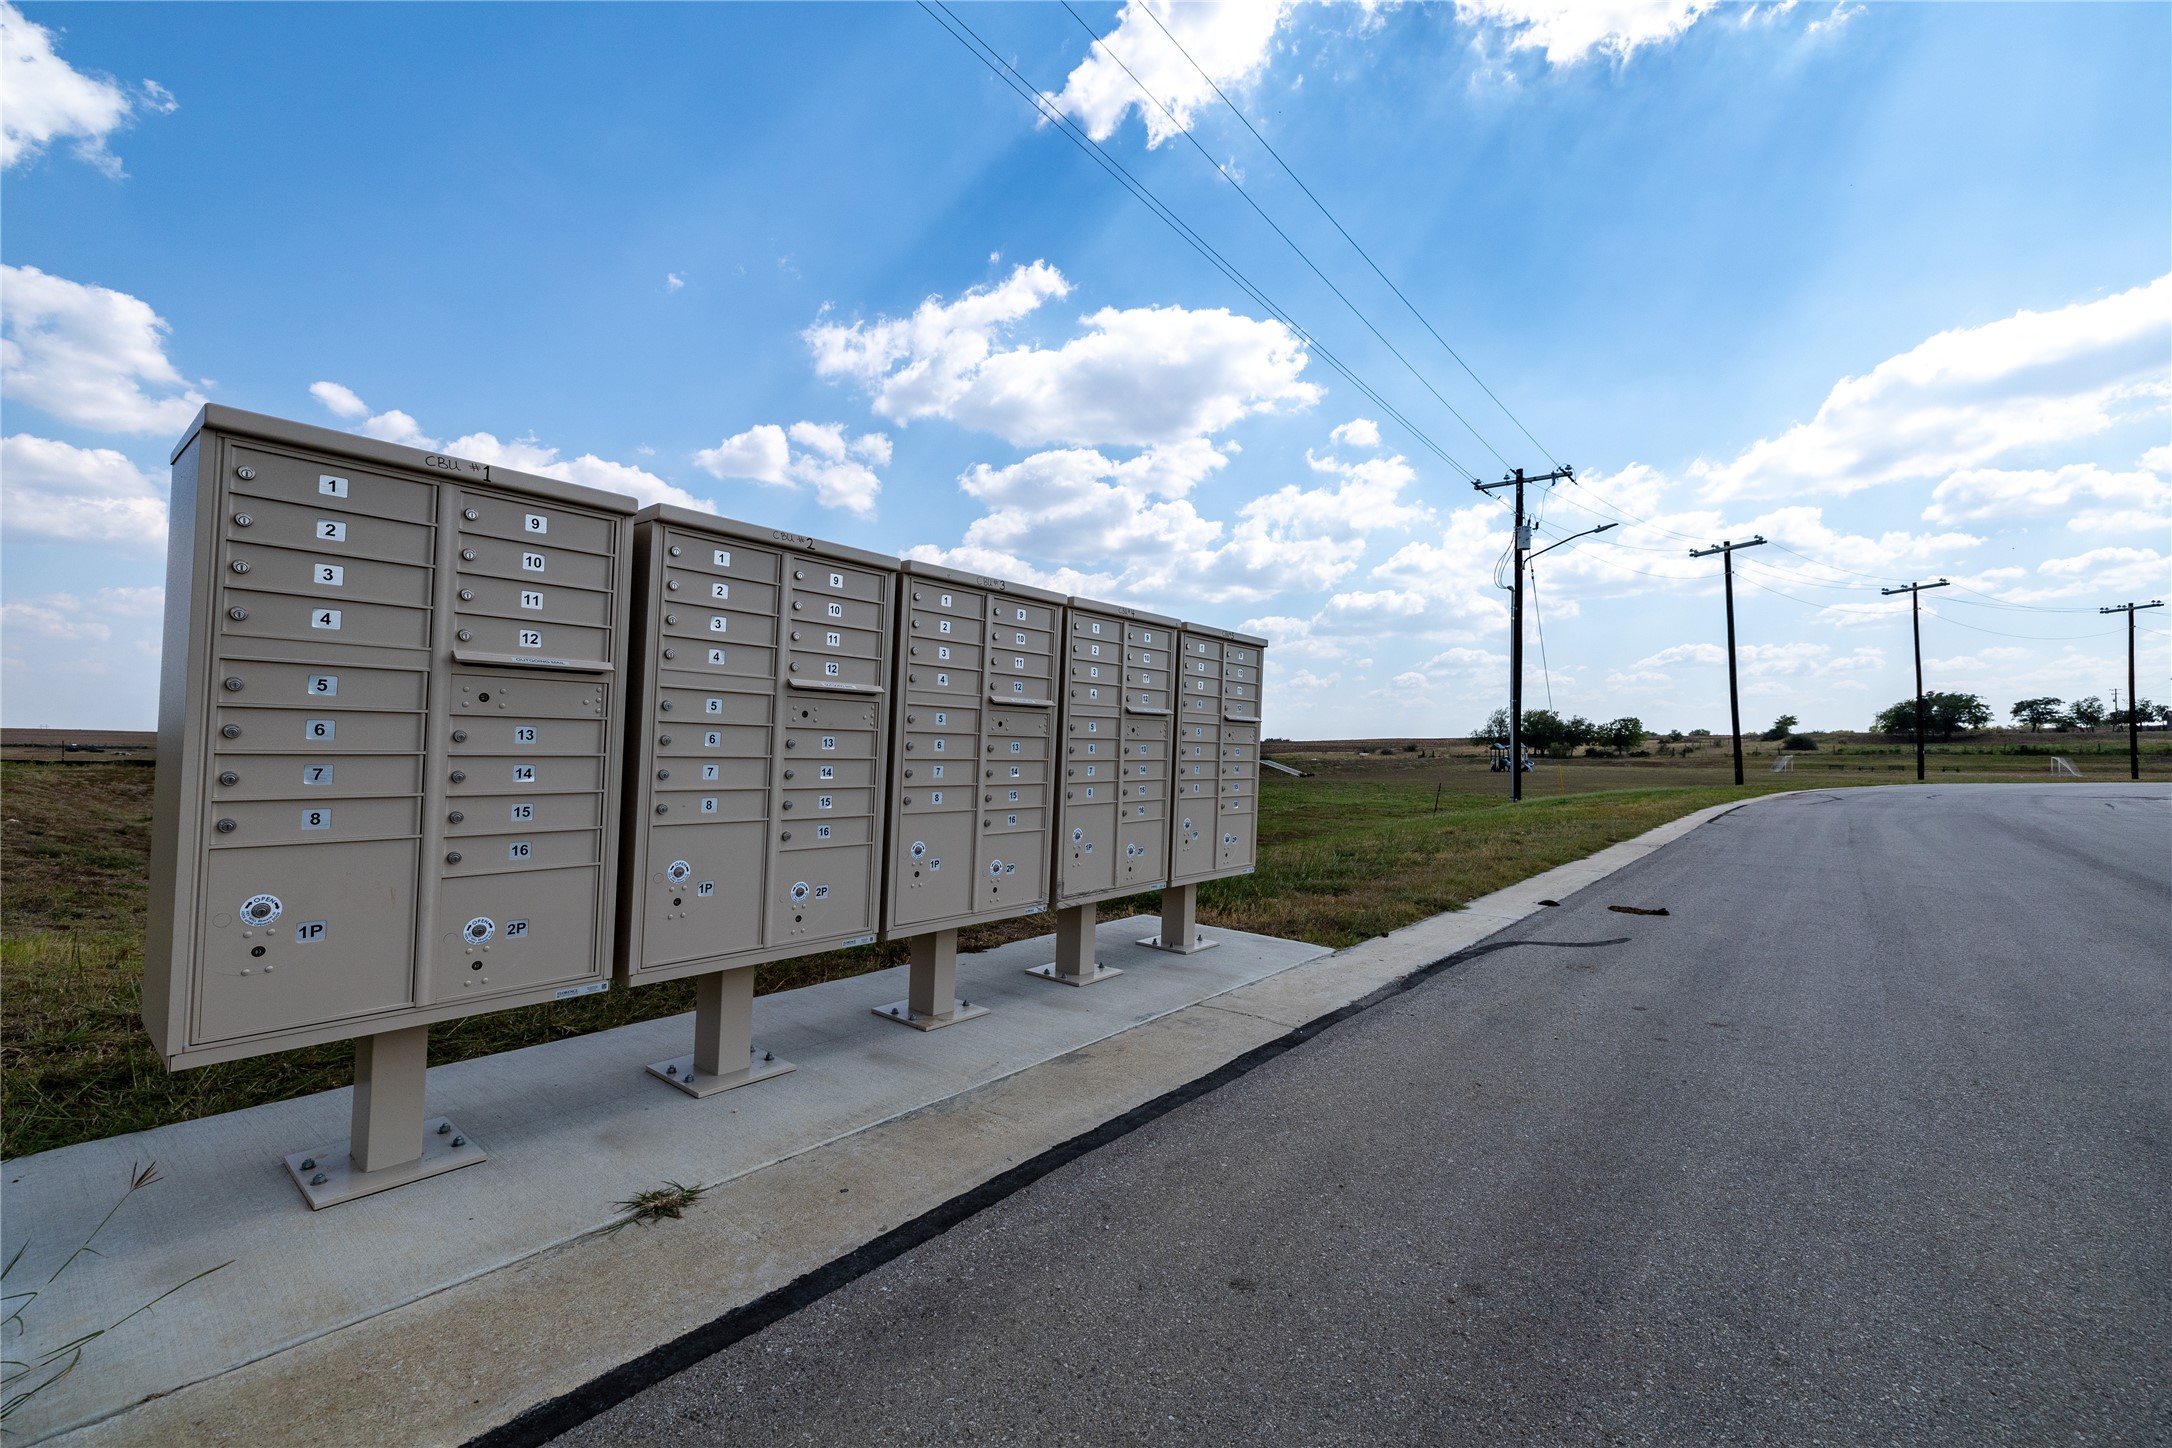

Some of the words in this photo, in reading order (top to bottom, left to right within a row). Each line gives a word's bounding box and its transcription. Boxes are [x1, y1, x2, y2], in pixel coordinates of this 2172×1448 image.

[425, 455, 461, 471] CBU
[469, 463, 491, 482] #1
[329, 480, 335, 492] 1
[532, 518, 539, 529] 9
[325, 524, 336, 536] 2
[773, 531, 795, 542] CBU
[526, 556, 541, 568] 10
[719, 554, 723, 563] 1
[323, 568, 333, 581] 3
[834, 576, 838, 585] 9
[717, 586, 723, 595] 2
[524, 594, 538, 606] 11
[830, 606, 840, 614] 10
[320, 613, 331, 625] 4
[715, 619, 721, 628] 3
[943, 623, 947, 631] 2
[522, 633, 538, 644] 12
[829, 635, 837, 643] 11
[713, 652, 719, 661] 4
[942, 649, 946, 657] 3
[828, 665, 837, 673] 12
[317, 679, 327, 691] 5
[711, 701, 717, 710] 5
[939, 715, 943, 723] 5
[315, 724, 325, 736] 6
[518, 729, 534, 740] 13
[709, 734, 715, 744] 6
[824, 738, 833, 747] 13
[937, 741, 941, 749] 6
[313, 768, 323, 780] 7
[516, 768, 532, 779] 14
[708, 767, 713, 776] 7
[822, 768, 832, 776] 14
[821, 798, 830, 806] 15
[935, 794, 939, 802] 8
[706, 801, 712, 810] 8
[514, 807, 530, 817] 15
[310, 813, 320, 825] 8
[819, 827, 829, 836] 16
[512, 845, 528, 856] 16
[931, 860, 939, 868] 1P
[699, 884, 712, 893] 1P
[816, 887, 827, 896] 2P
[254, 896, 276, 904] OPEN
[299, 925, 322, 938] 1P
[507, 923, 526, 935] 2P
